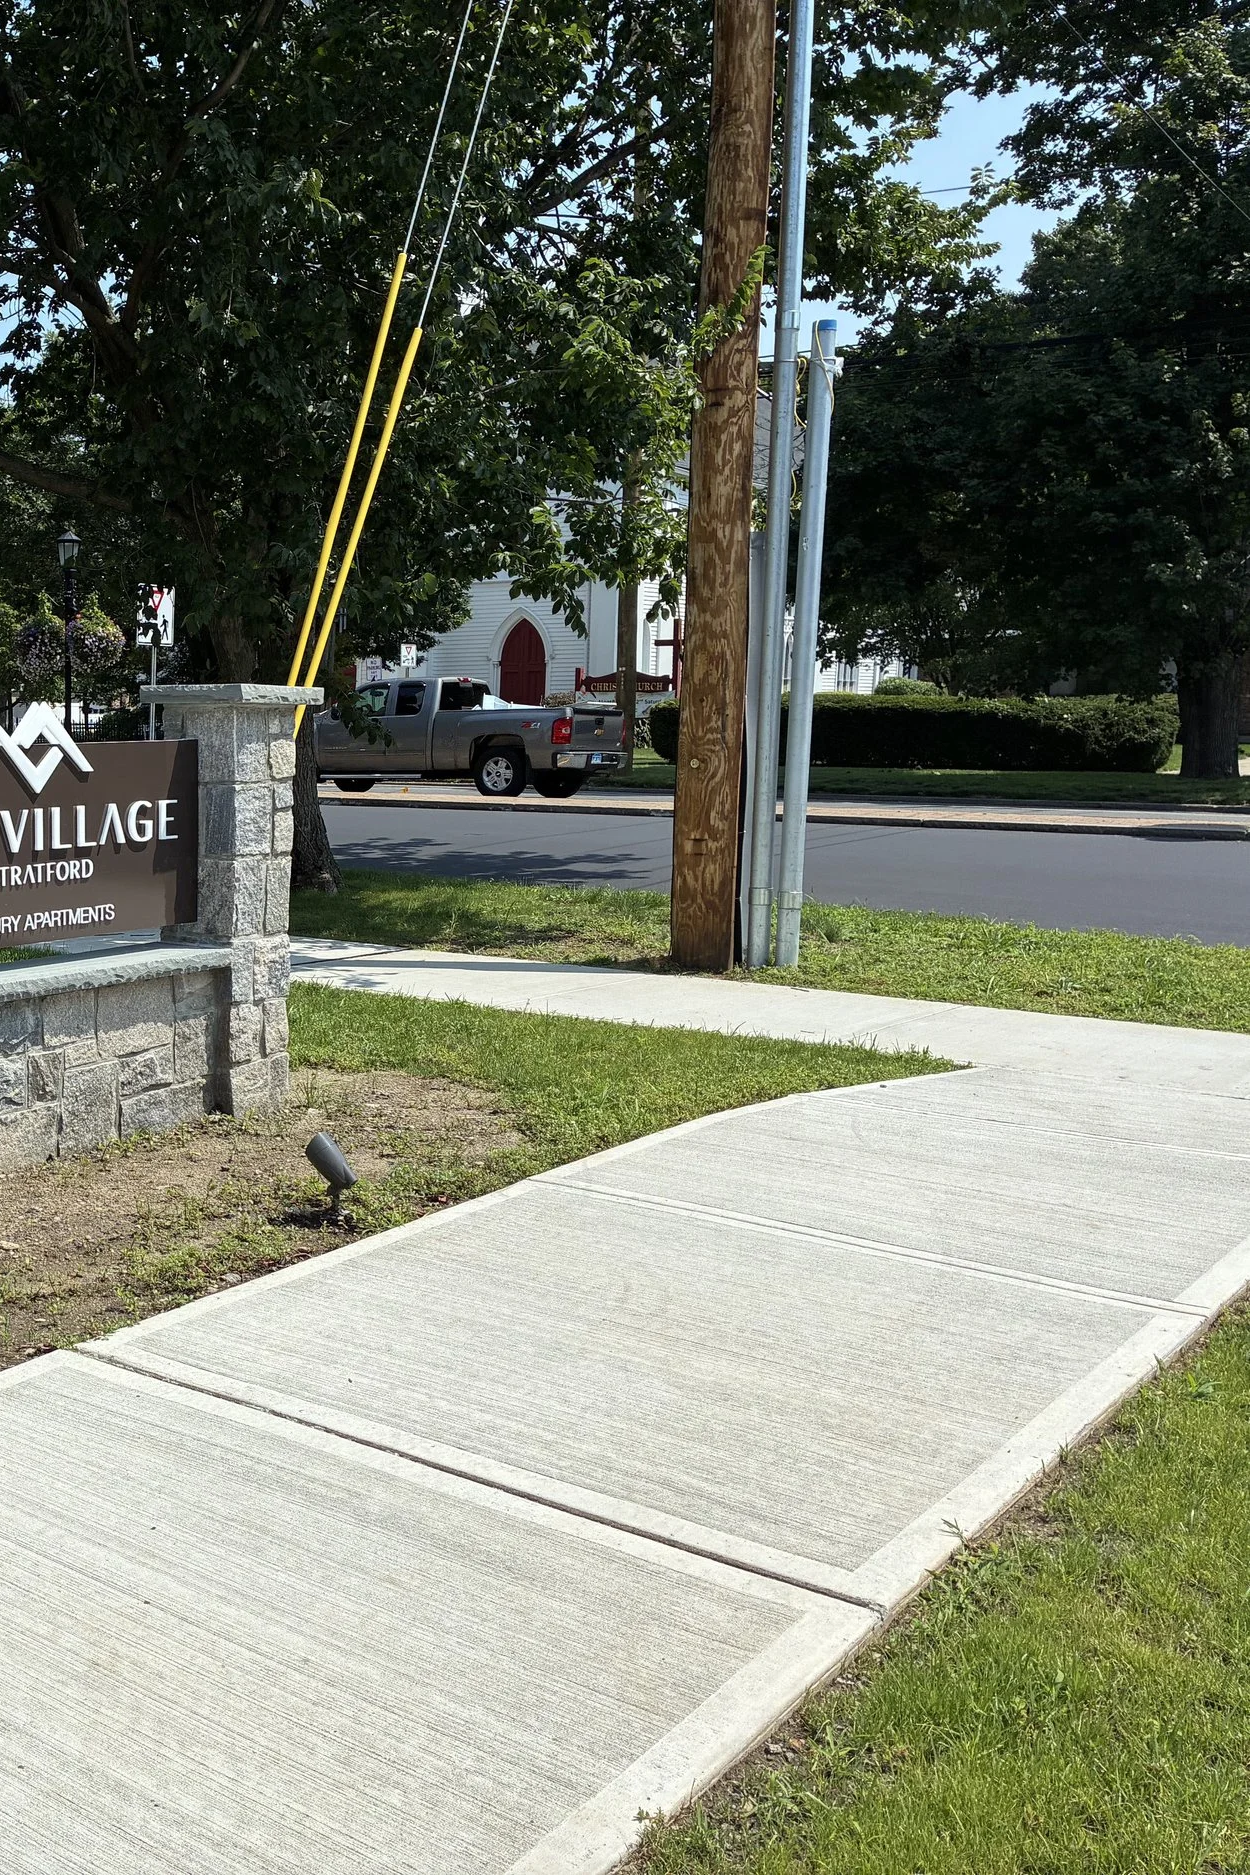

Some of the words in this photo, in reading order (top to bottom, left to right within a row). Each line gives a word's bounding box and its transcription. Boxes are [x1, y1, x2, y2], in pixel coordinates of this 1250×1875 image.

[590, 682, 618, 691] CHRIS
[635, 682, 663, 691] URCH
[23, 903, 116, 932] APARTMENTS
